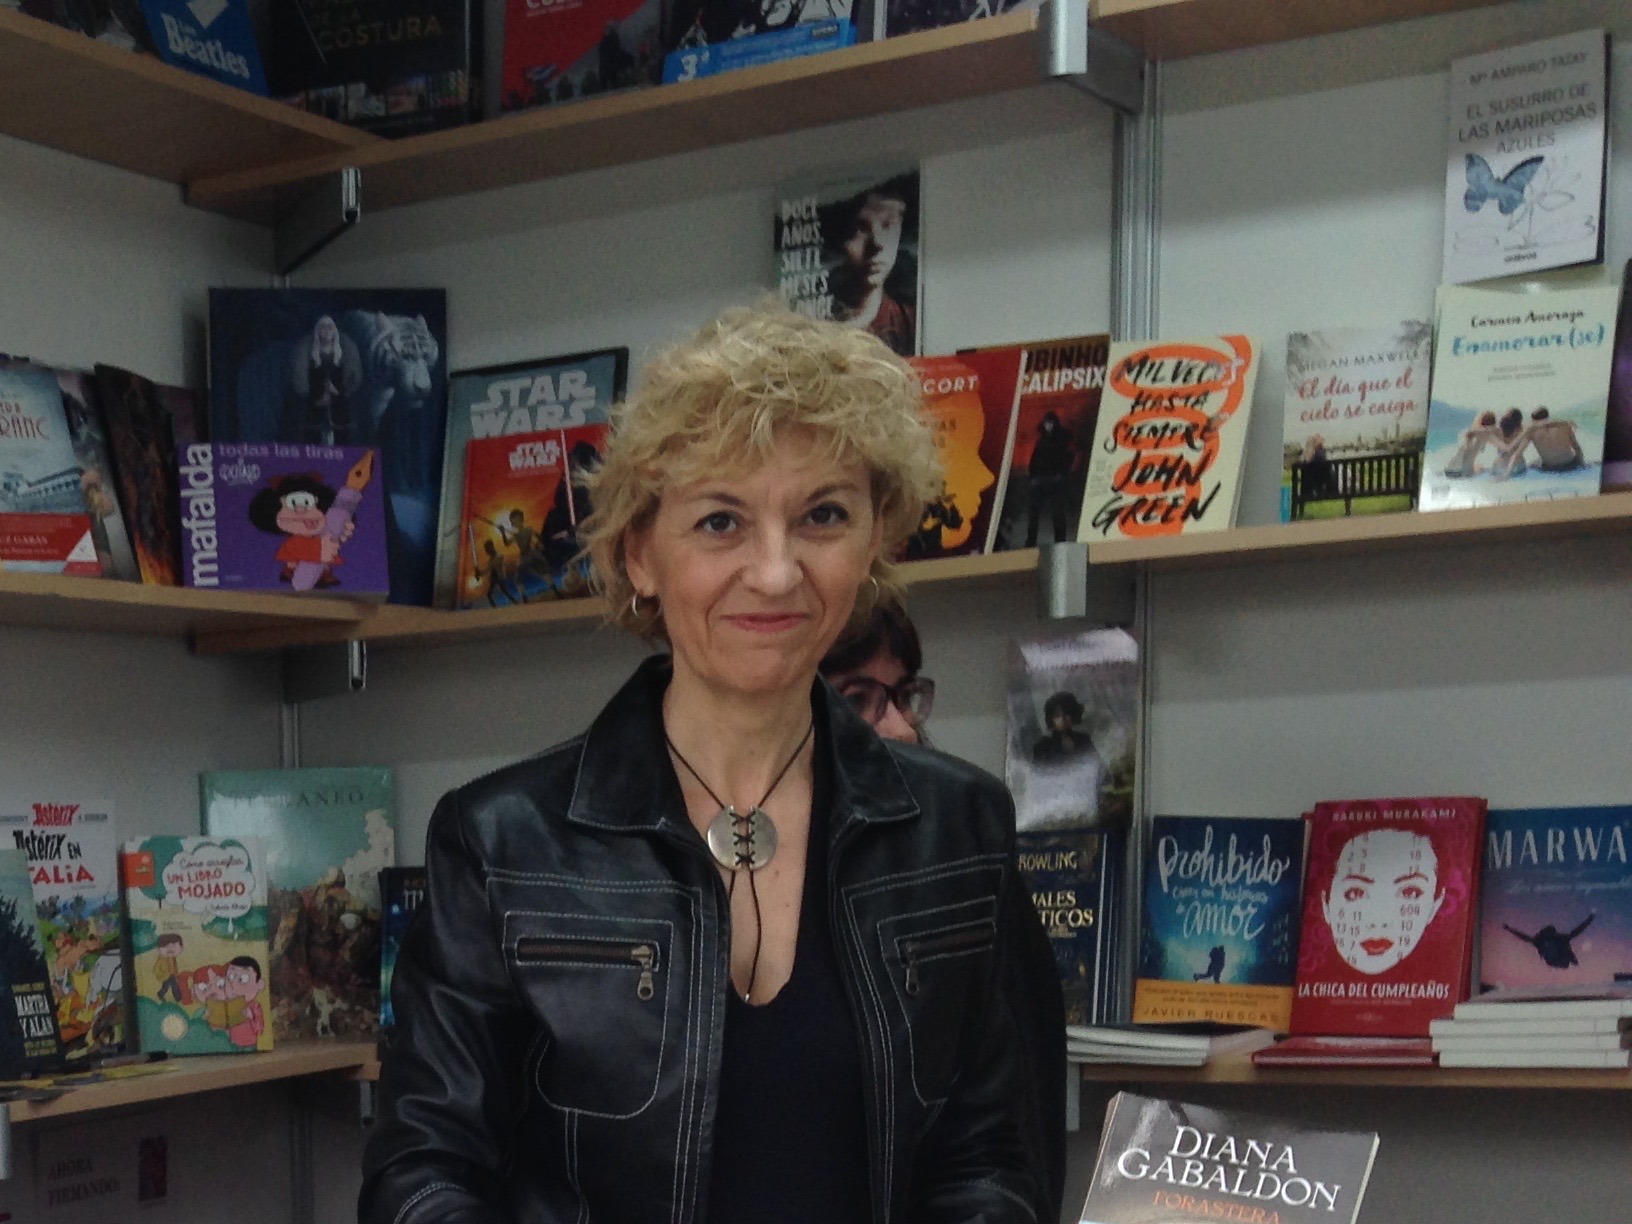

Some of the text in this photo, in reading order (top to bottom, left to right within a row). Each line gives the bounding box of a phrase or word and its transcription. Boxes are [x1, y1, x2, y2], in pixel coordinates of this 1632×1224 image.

[1458, 101, 1597, 143] LAS MARIPOSAS
[485, 369, 597, 412] STAR
[1396, 366, 1413, 389] el
[1130, 389, 1209, 416] HASTA
[470, 399, 587, 440] WARS
[1104, 412, 1226, 453] SIEMPRE
[218, 442, 344, 461] todas las tiras
[1112, 451, 1212, 491] JOHN
[182, 443, 219, 588] mafalda
[1091, 483, 1222, 536] GREEN
[1383, 807, 1457, 821] MURAKAMI
[68, 842, 82, 859] EN
[1018, 851, 1077, 872] ROWLING
[167, 868, 222, 885] UN LIBRO
[178, 882, 246, 899] MOJADO
[1298, 984, 1310, 998] LA
[1313, 982, 1346, 997] CHICA
[1348, 983, 1368, 997] DEL
[1371, 980, 1450, 1000] CUMPLEAÑOS
[1167, 1125, 1298, 1175] DIANA
[1117, 1147, 1343, 1213] GABALDON
